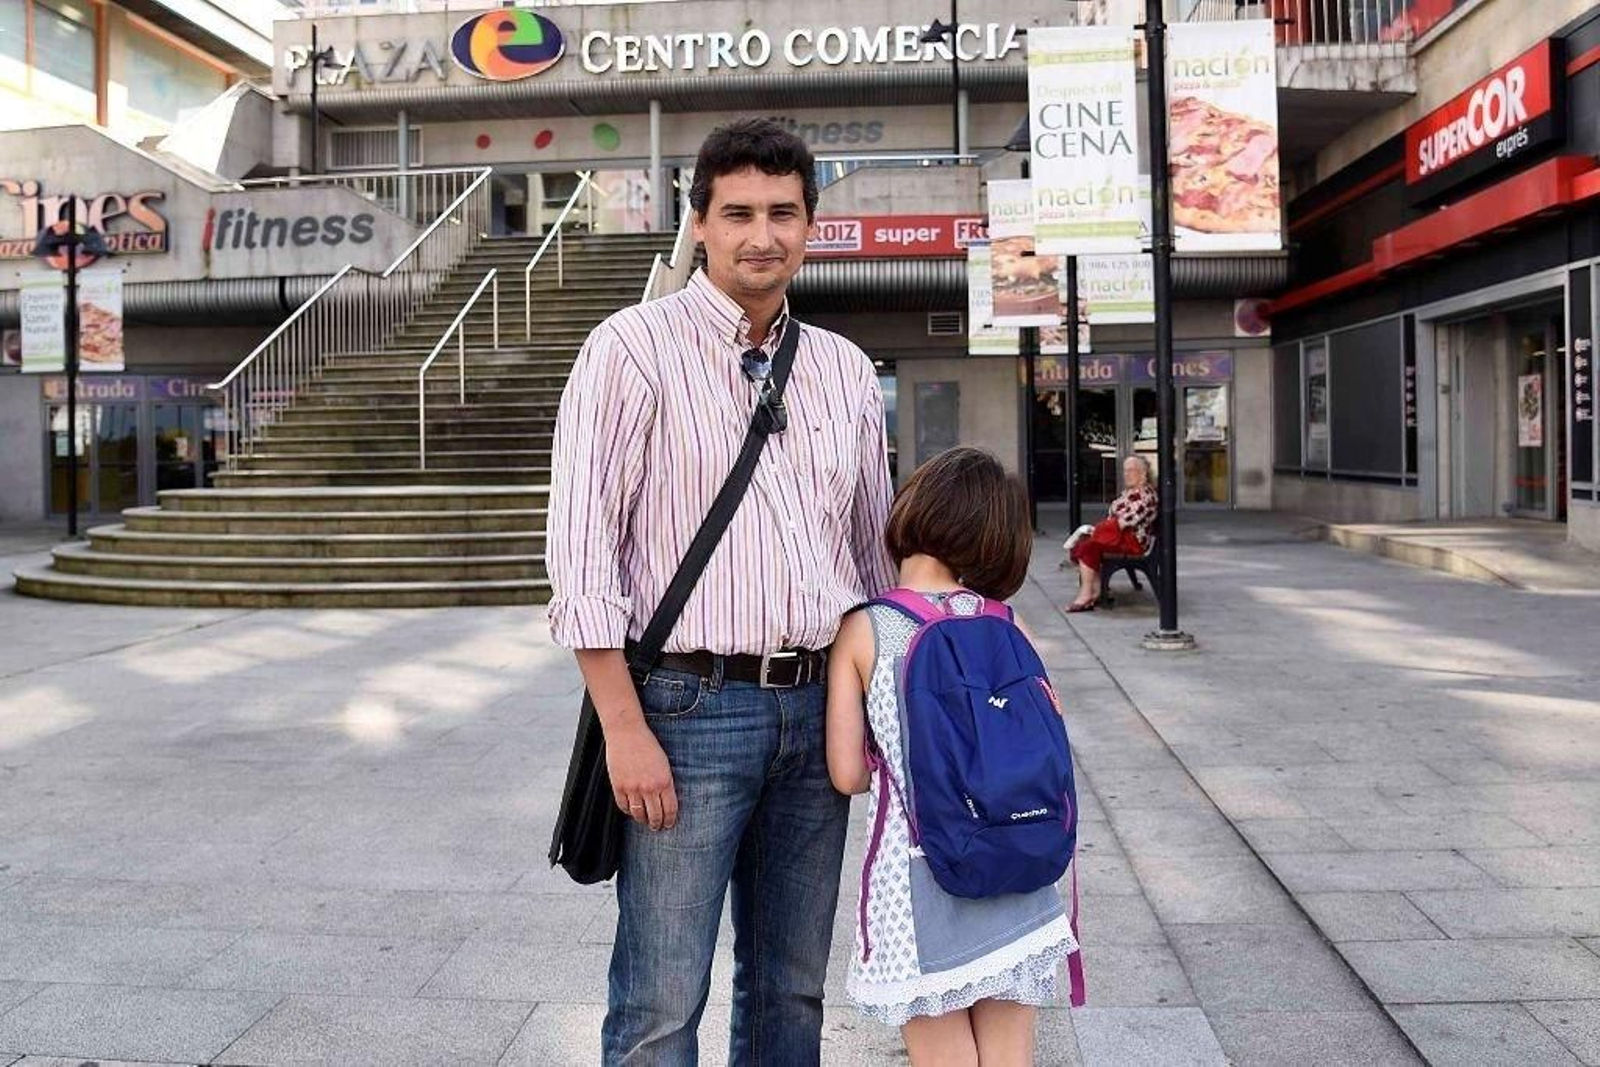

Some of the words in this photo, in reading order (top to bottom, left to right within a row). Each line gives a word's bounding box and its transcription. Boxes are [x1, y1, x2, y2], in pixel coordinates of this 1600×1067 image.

[582, 29, 770, 73] CENTRO
[1038, 100, 1124, 130] CINE
[1418, 66, 1528, 175] SUPERCOR
[1034, 129, 1133, 159] CENA
[1038, 175, 1134, 208] nación
[874, 225, 941, 244] super
